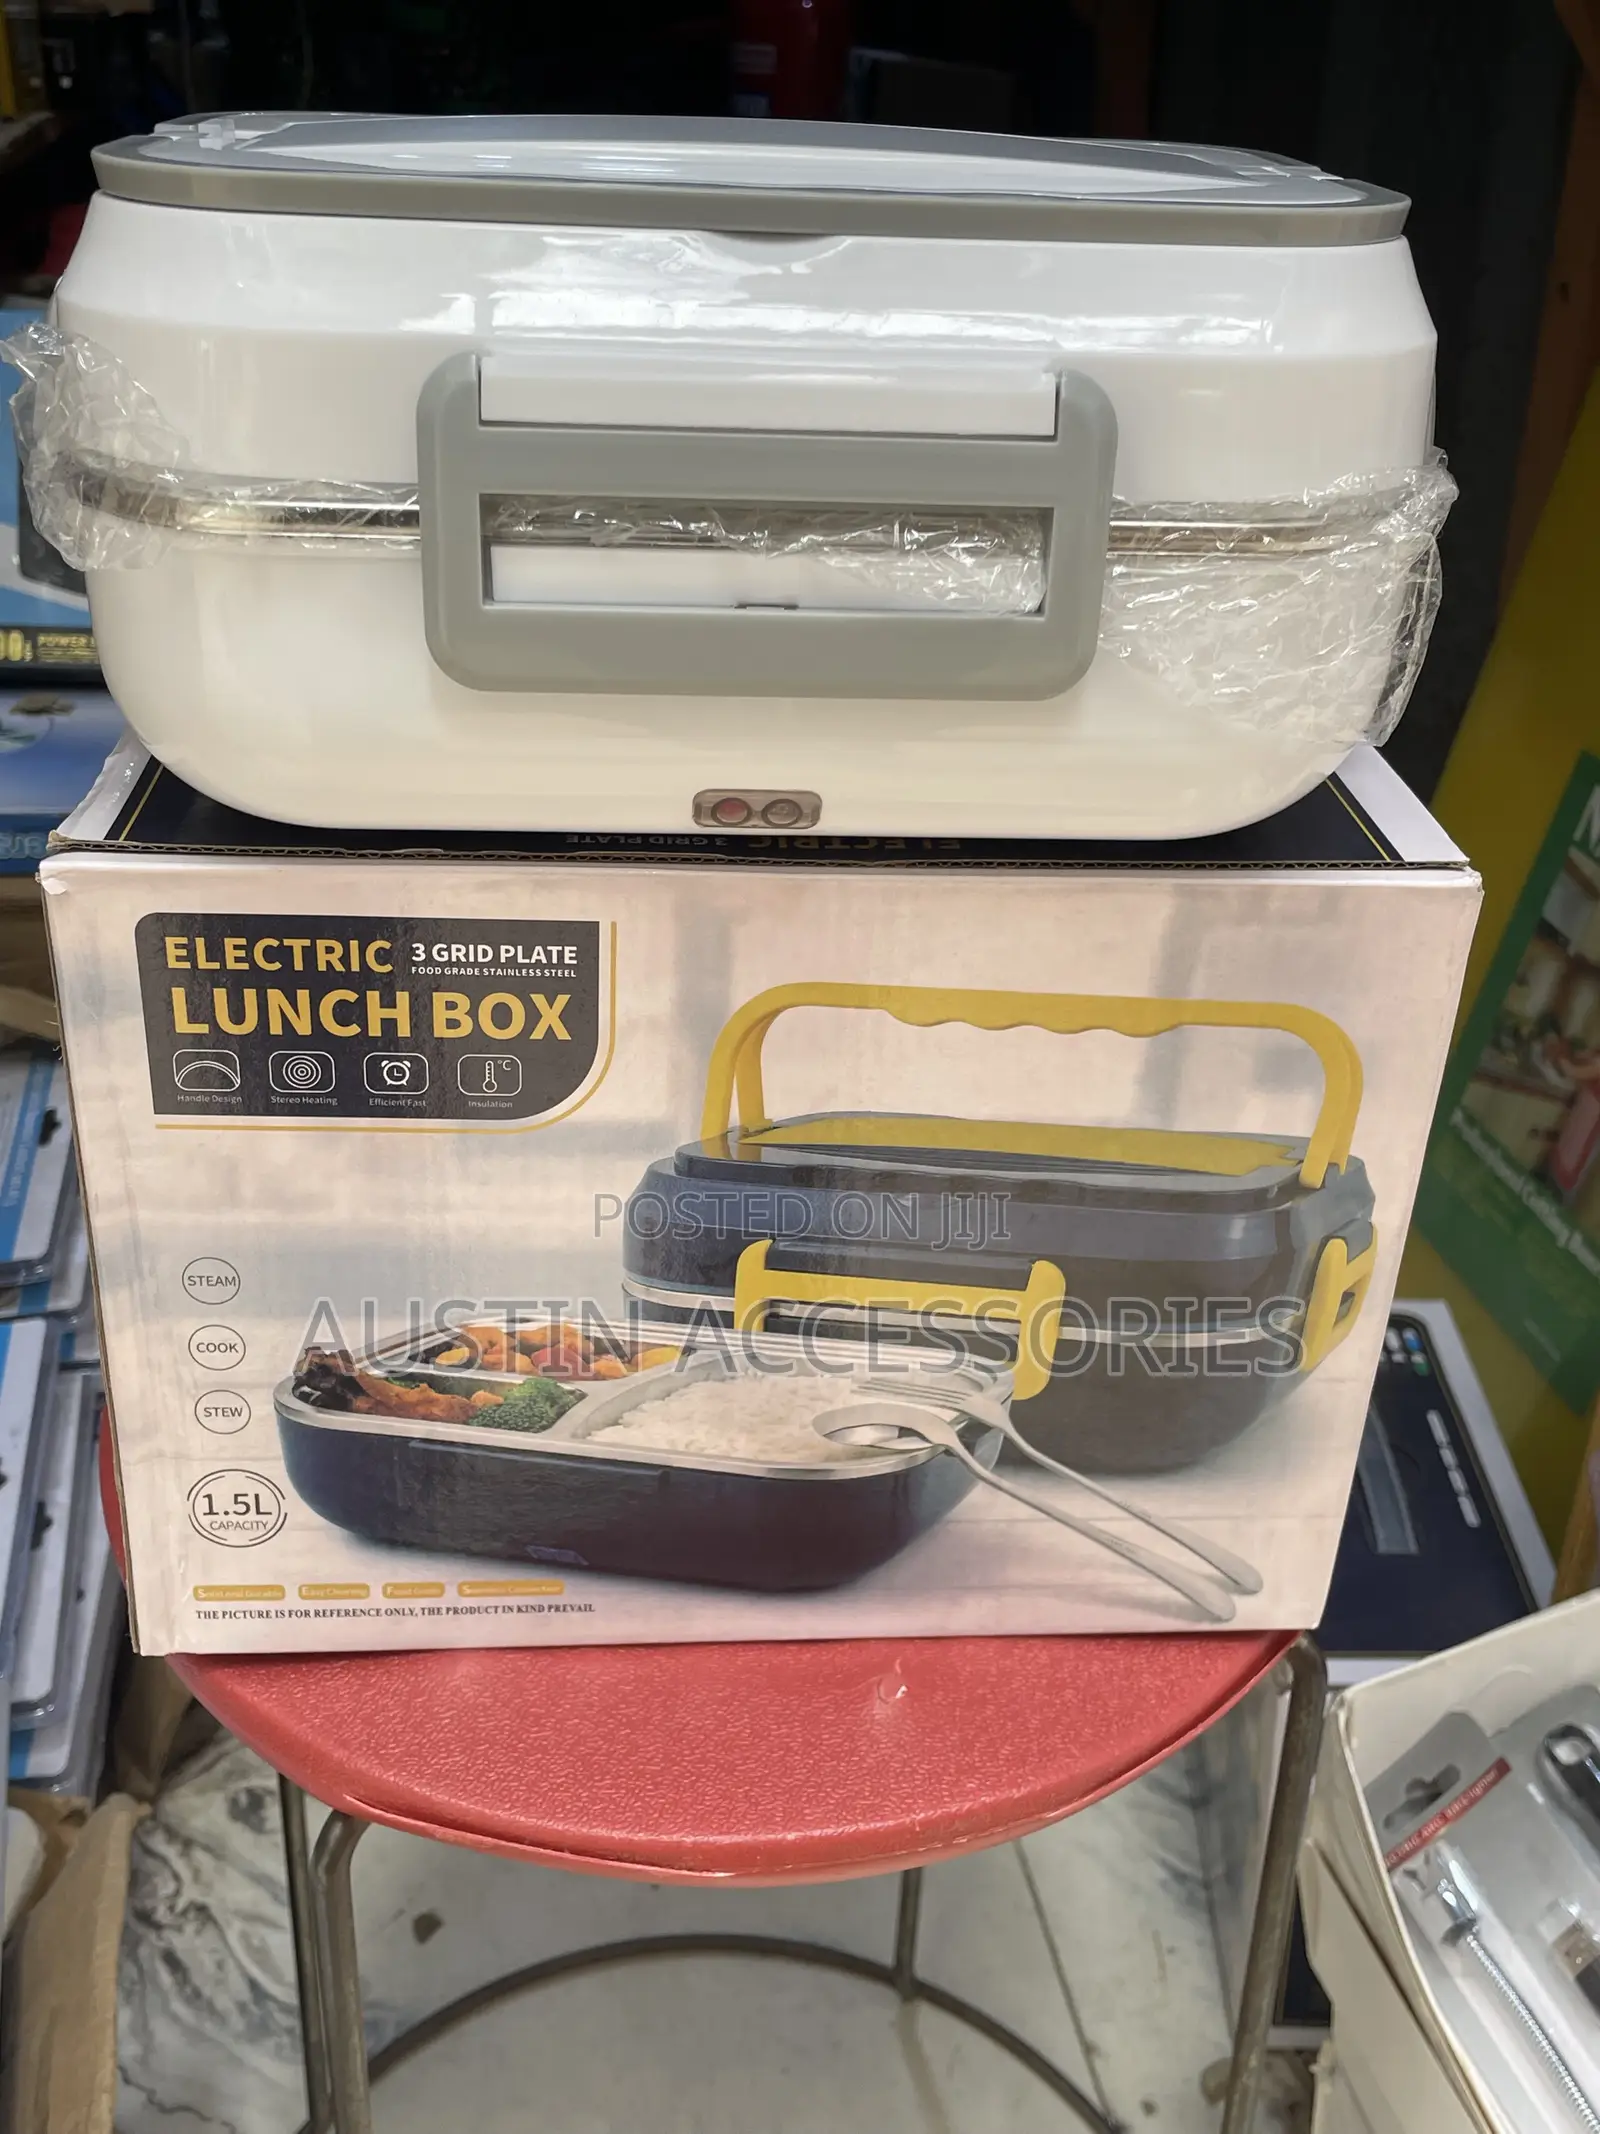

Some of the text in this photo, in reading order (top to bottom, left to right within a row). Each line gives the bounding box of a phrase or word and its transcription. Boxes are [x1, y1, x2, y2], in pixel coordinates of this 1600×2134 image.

[565, 834, 643, 845] PLATE
[648, 835, 709, 846] GRID
[164, 936, 393, 973] ELECTRIC
[411, 943, 578, 965] 3 GRID PLATE
[411, 967, 577, 978] FOOD GRADE STAINLESS STEEL
[171, 987, 572, 1041] LUNCH BOX
[177, 1094, 243, 1104] Handle Design
[270, 1095, 339, 1106] Stereo Heating
[369, 1097, 427, 1108] Efficient Fast
[468, 1100, 513, 1108] Insulation
[187, 1274, 237, 1288] STEAM
[195, 1341, 240, 1354] COOK
[203, 1405, 243, 1419] STEW
[201, 1492, 273, 1517] 1.5L
[209, 1519, 269, 1532] CAPACITY
[196, 1603, 596, 1620] THE PICTURE IS FOR REFERENCE ONLY, THE PRODUCT IN KIND PREVAIL
